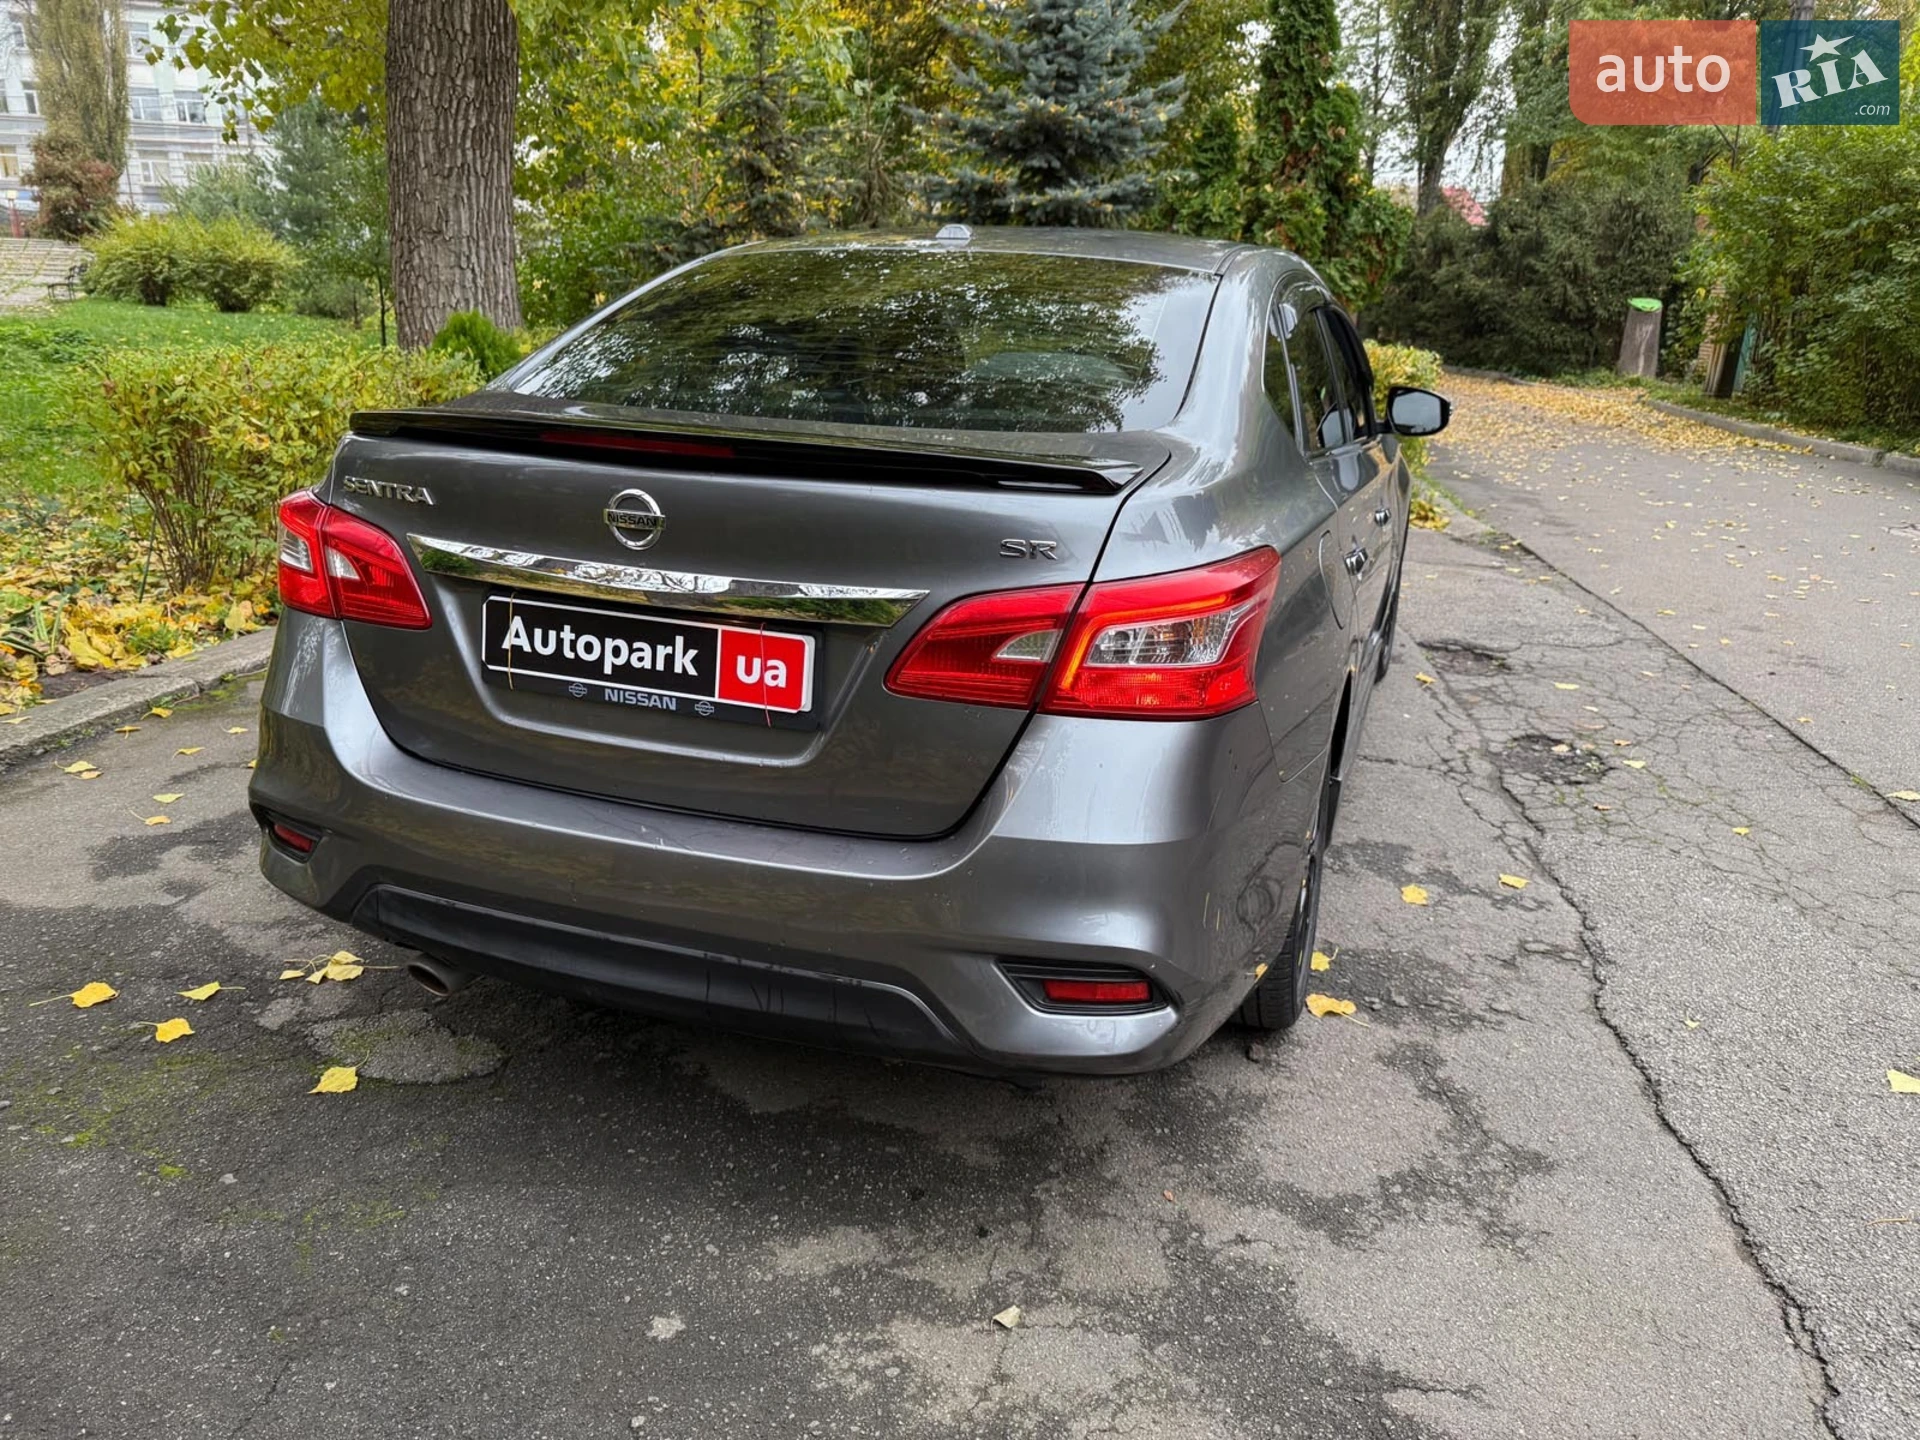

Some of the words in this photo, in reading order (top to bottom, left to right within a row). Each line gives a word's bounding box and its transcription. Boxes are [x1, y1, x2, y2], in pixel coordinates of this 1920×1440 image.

[343, 475, 434, 505] SENTRA
[608, 512, 657, 526] NISSAN
[1000, 538, 1057, 560] SR
[502, 615, 699, 675] Autopark
[736, 654, 787, 688] ua
[604, 688, 676, 711] NISSAN
